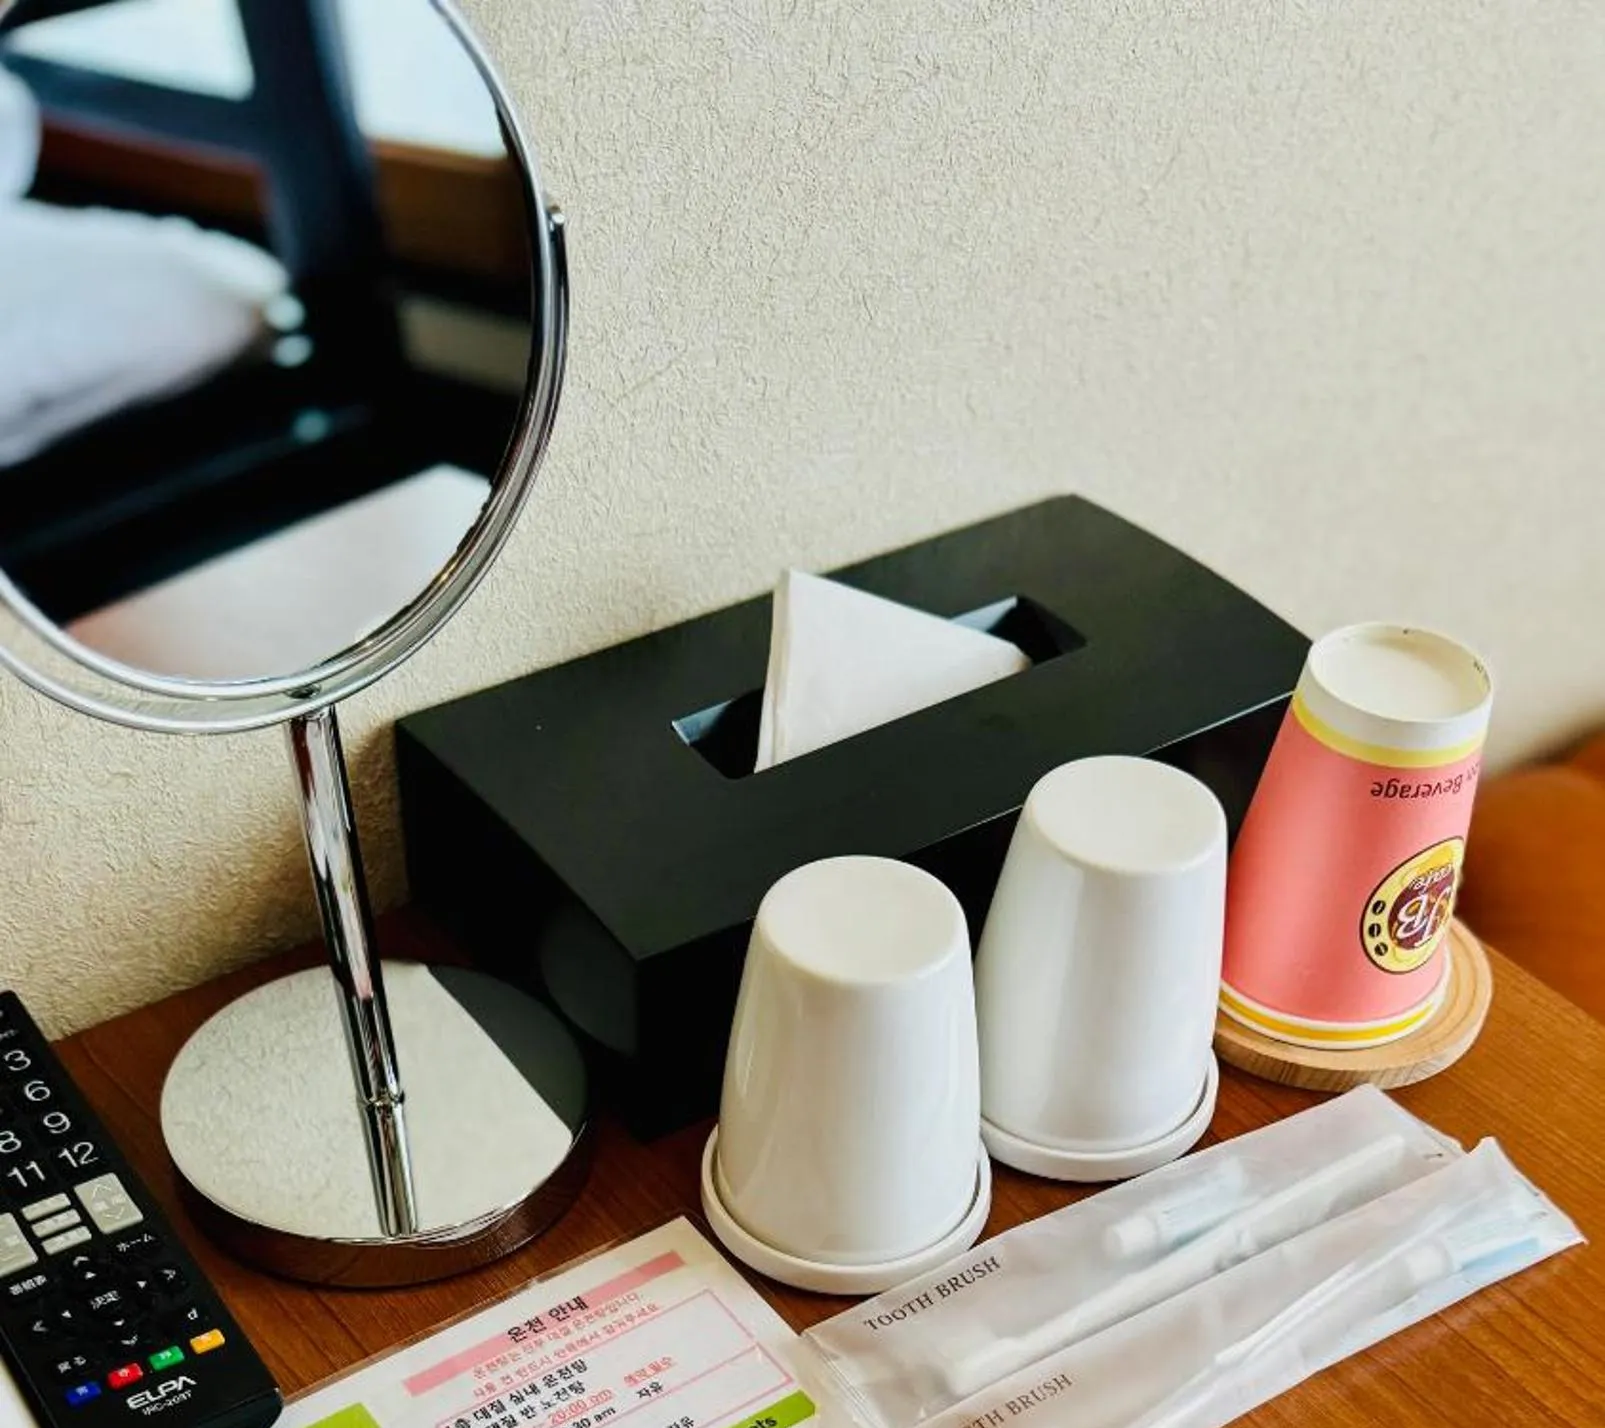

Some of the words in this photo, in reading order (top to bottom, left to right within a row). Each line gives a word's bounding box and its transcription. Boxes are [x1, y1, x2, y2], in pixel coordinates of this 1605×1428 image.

[1370, 774, 1464, 798] Beverage
[4, 1050, 31, 1071] 3
[24, 1080, 50, 1101] 6
[43, 1112, 71, 1133] 9
[58, 1141, 99, 1168] 12
[7, 1160, 46, 1188] 11
[863, 1293, 935, 1331] TOOTH
[935, 1256, 1002, 1299] BRUSH
[504, 1315, 547, 1343] 온천
[545, 1295, 590, 1323] 안내
[126, 1376, 197, 1411] ELPA
[592, 1406, 617, 1422] am
[634, 1380, 666, 1400] 자유
[1005, 1373, 1073, 1416] BRUSH
